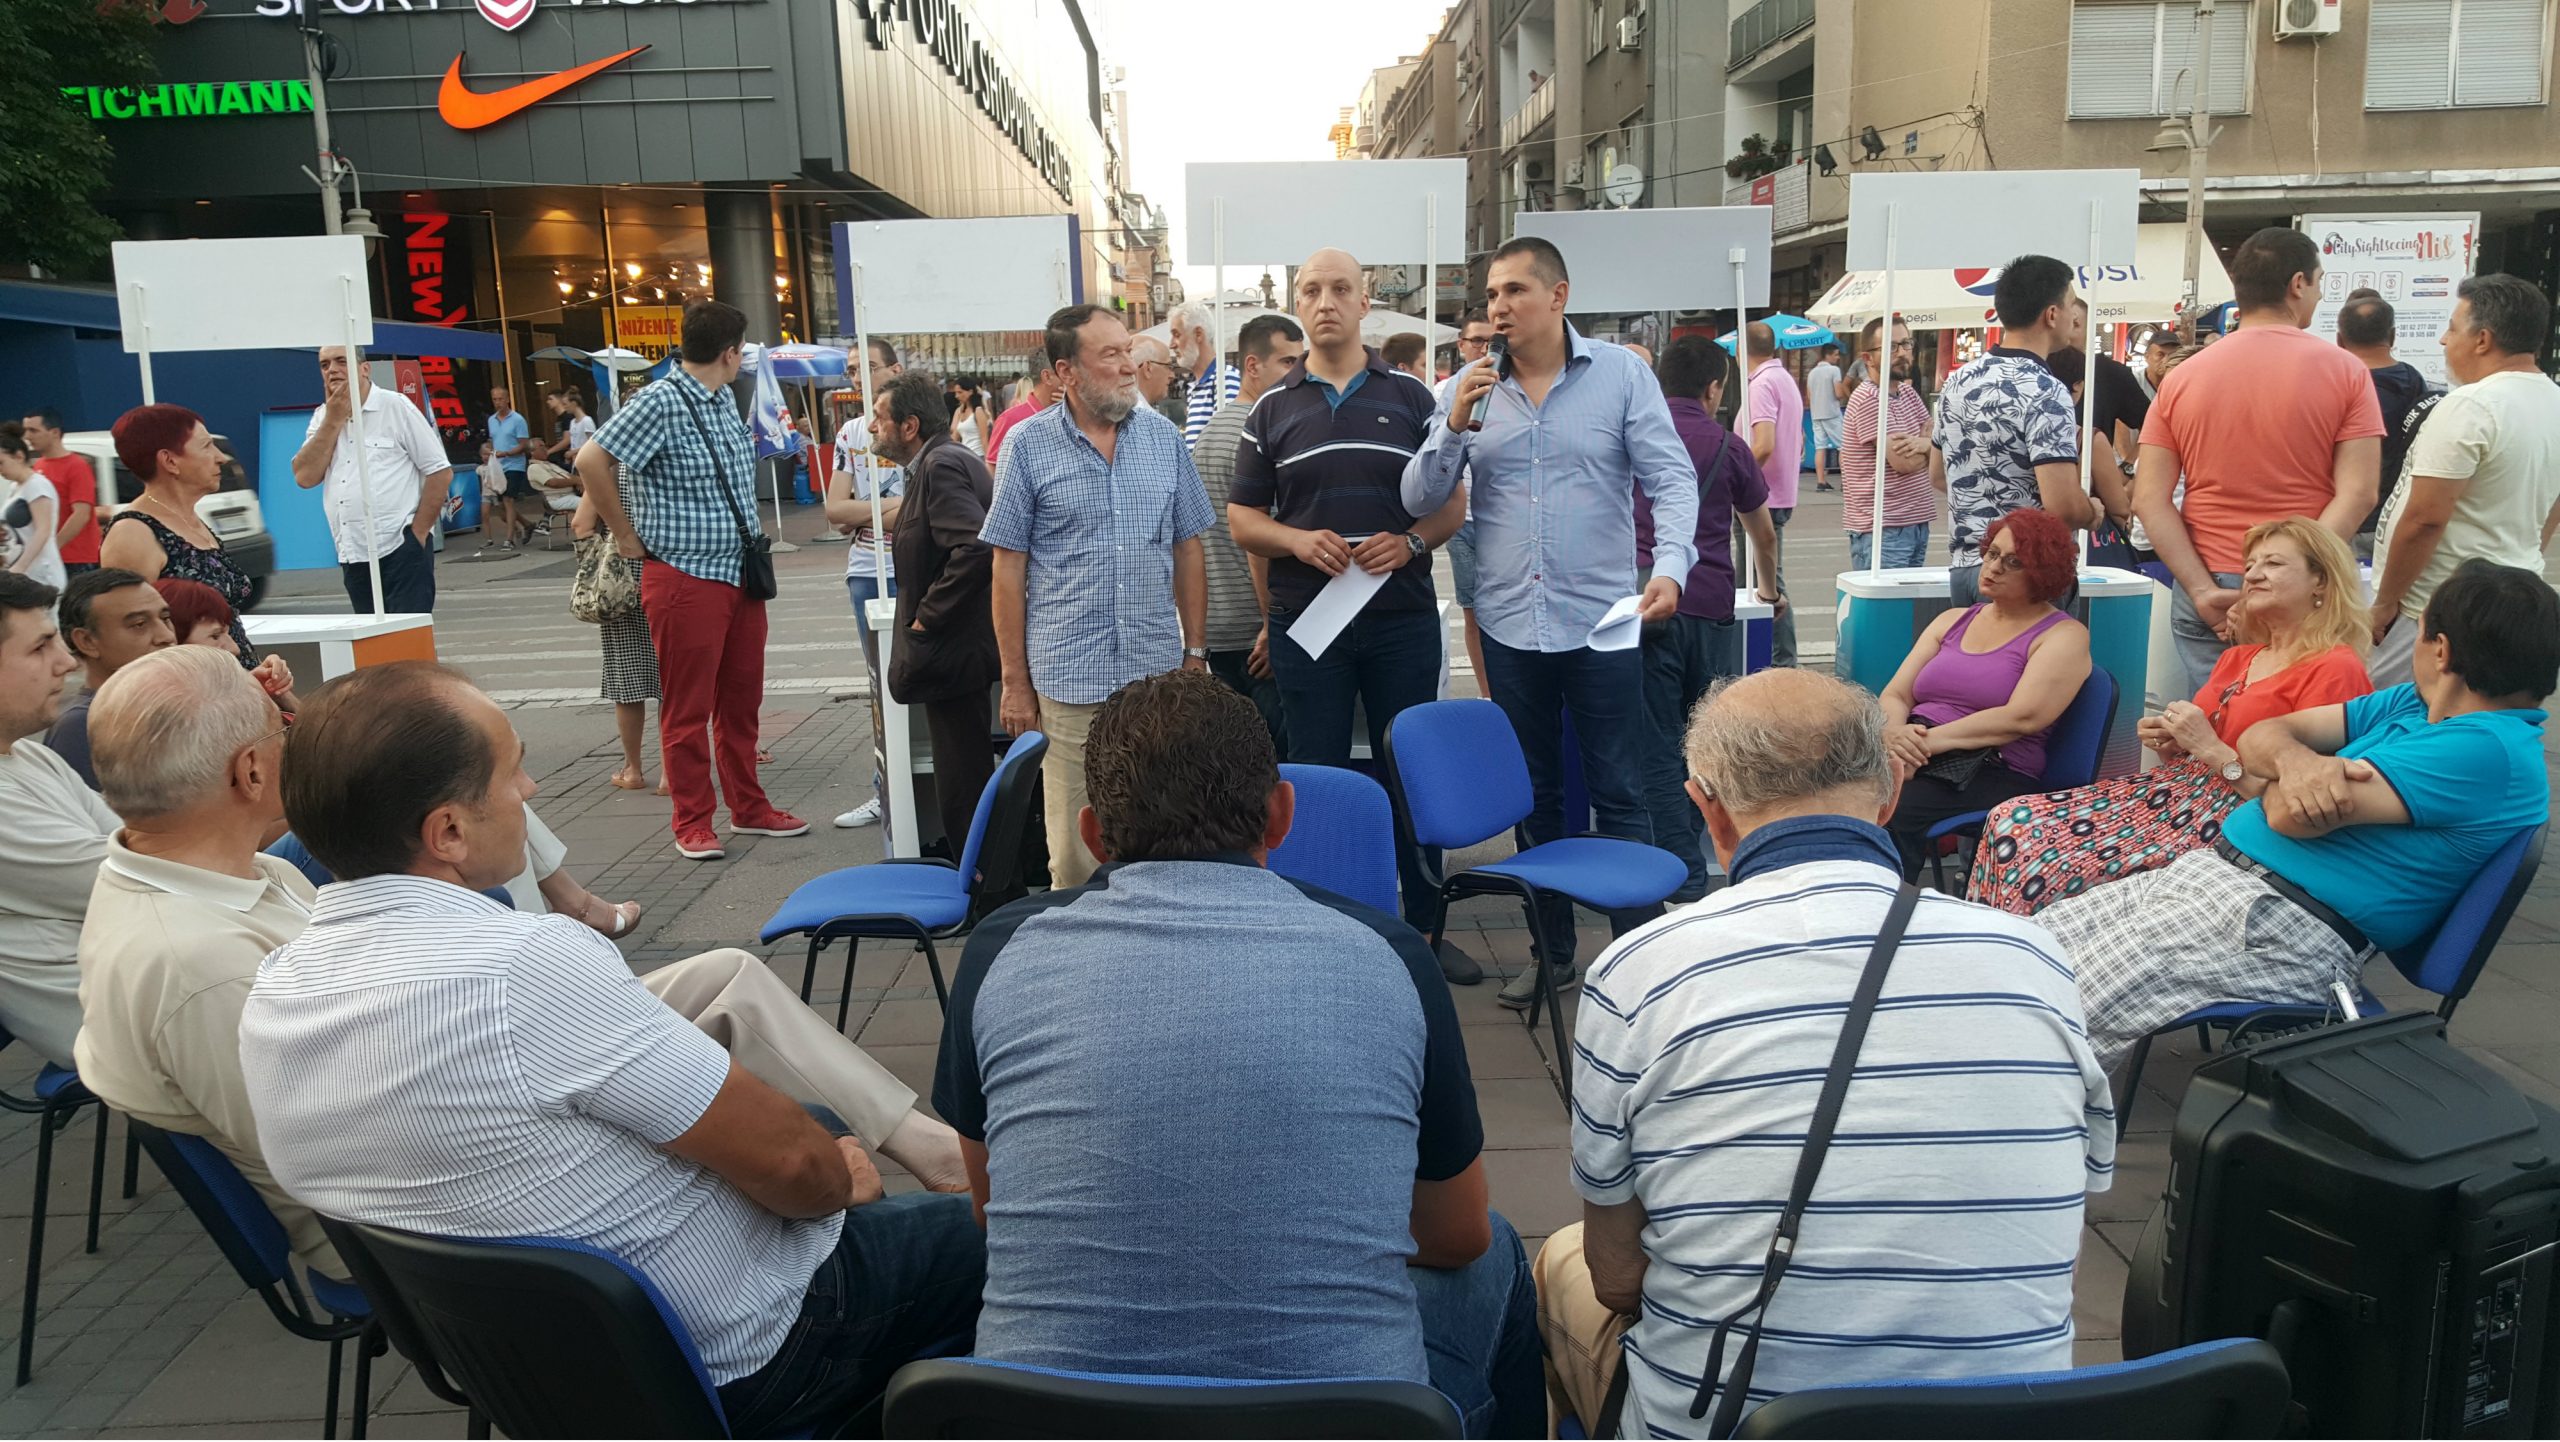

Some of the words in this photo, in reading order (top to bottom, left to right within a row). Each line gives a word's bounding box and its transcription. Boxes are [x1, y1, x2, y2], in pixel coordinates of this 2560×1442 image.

[979, 45, 1043, 169] SHOPPING
[1042, 131, 1074, 206] CENTER
[402, 213, 449, 319] NEW
[1906, 312, 1937, 325] pepsi
[623, 375, 645, 384] KING
[2401, 408, 2420, 433] LOOK
[2416, 393, 2444, 410] BACK
